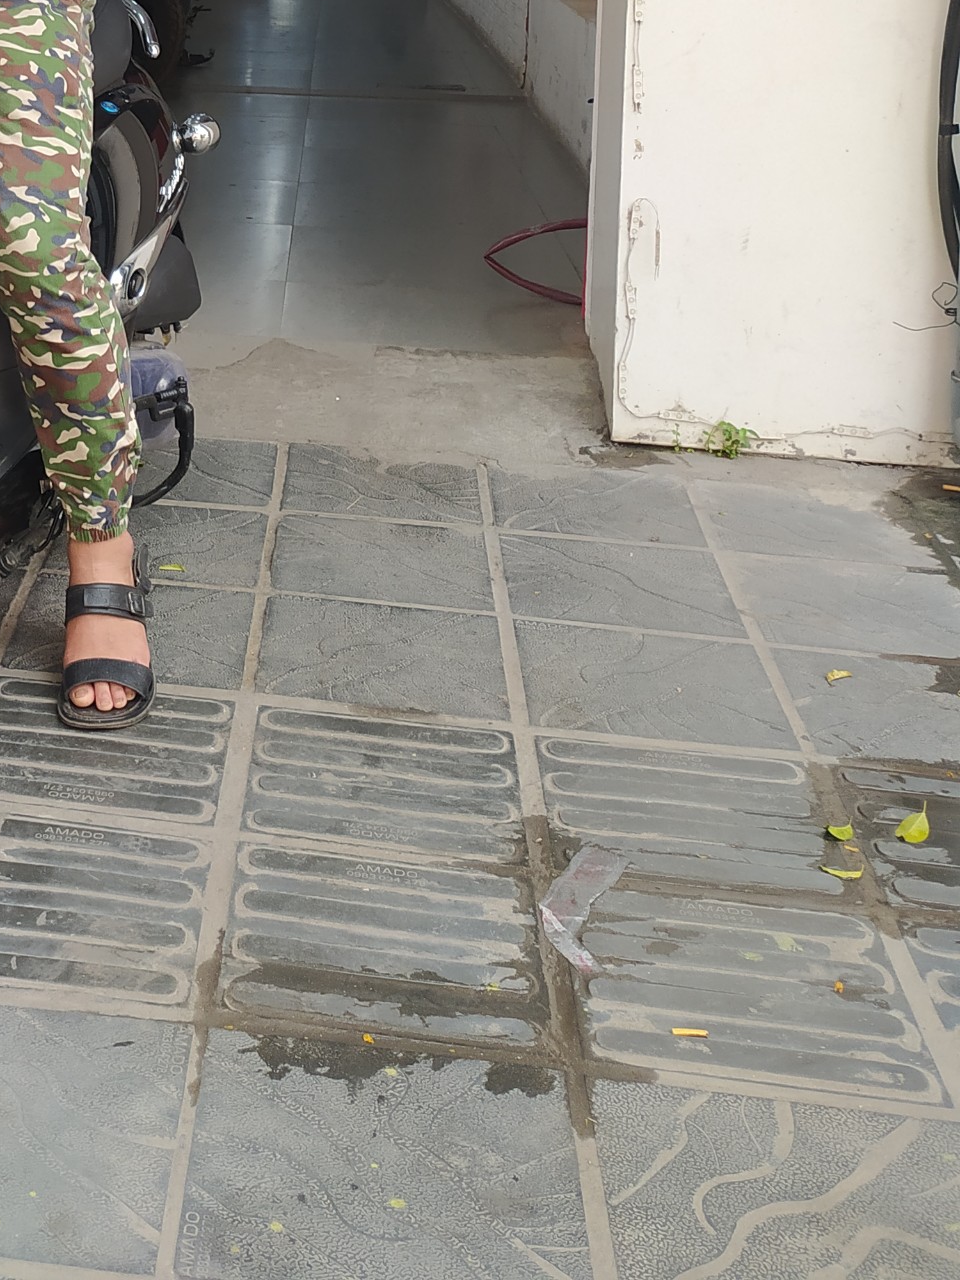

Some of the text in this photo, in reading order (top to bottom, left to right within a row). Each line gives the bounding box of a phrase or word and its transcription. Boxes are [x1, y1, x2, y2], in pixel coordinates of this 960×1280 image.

[48, 791, 106, 802] AMADO
[44, 826, 104, 840] AMADO
[349, 828, 410, 842] AMADO
[355, 863, 418, 878] AMADO
[687, 903, 753, 917] AMADO
[179, 1211, 200, 1277] AMADO
